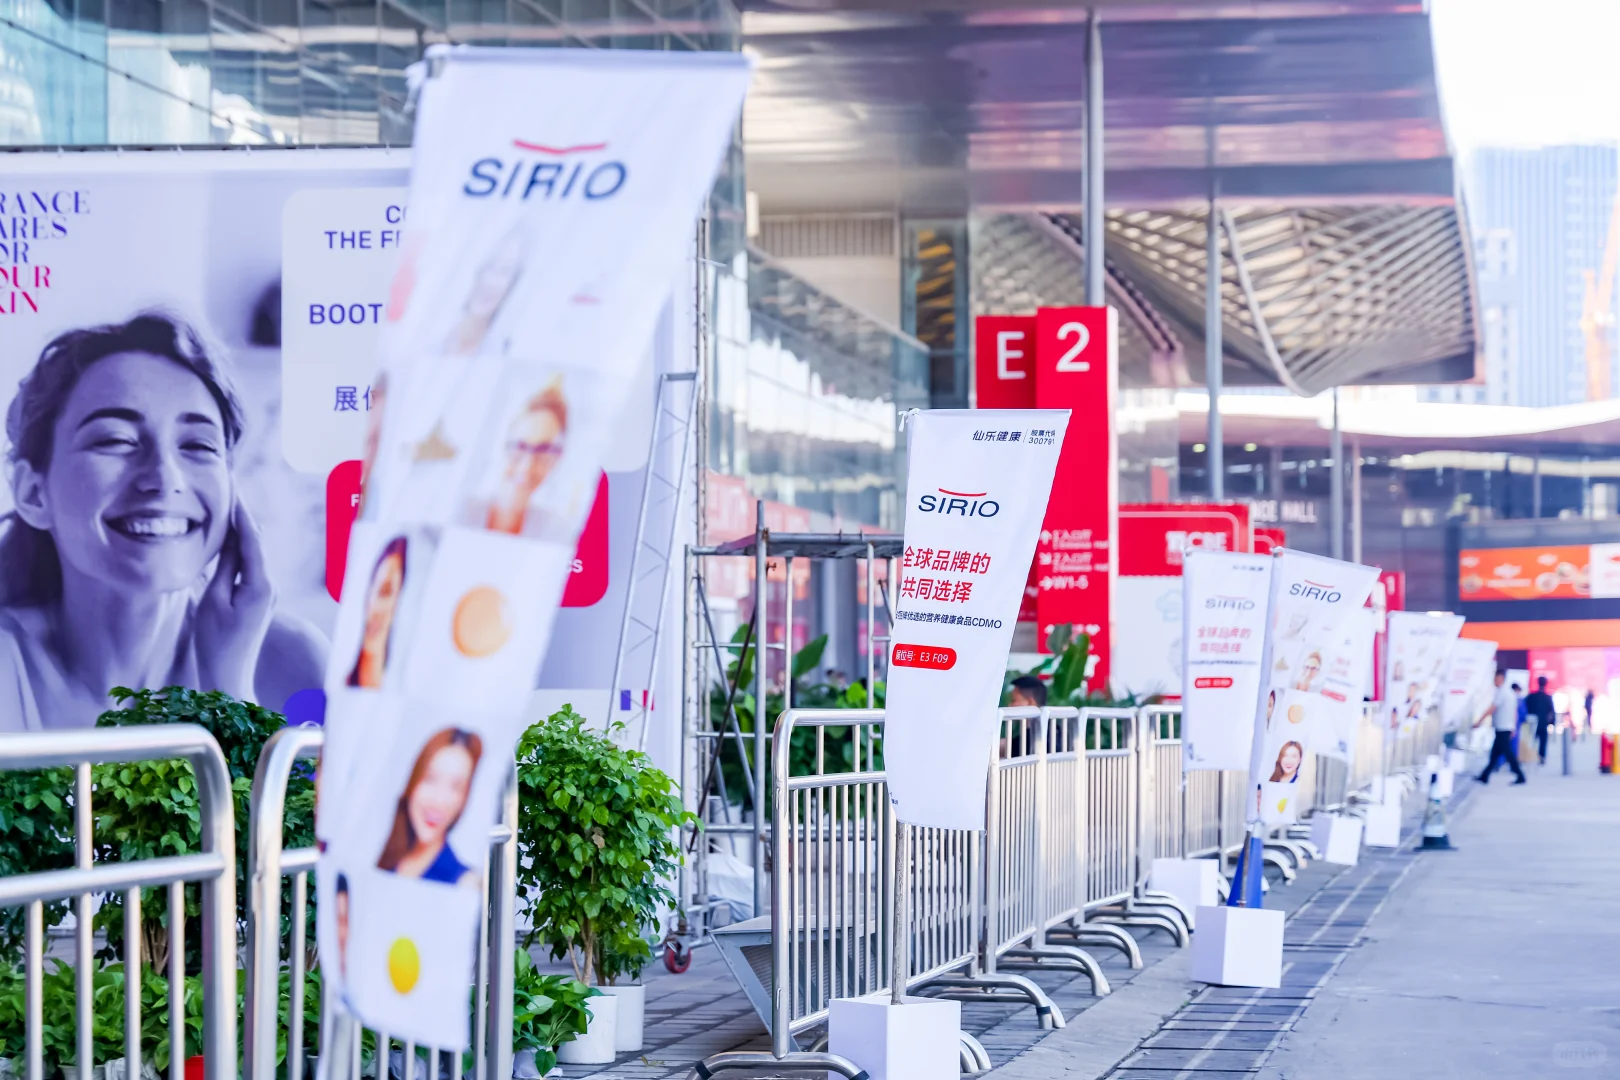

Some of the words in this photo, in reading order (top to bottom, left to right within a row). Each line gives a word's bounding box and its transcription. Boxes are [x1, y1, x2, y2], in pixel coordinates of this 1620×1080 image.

[463, 157, 629, 200] SIRIO
[386, 205, 407, 223] C
[324, 230, 372, 248] THE
[997, 331, 1026, 380] E
[1055, 321, 1091, 373] 2
[972, 430, 1022, 442] 仙乐健康
[918, 494, 1000, 518] SIRIO
[903, 545, 992, 574] 全球品牌的
[902, 576, 973, 603] 共同选择
[1289, 583, 1342, 603] SIRIO
[920, 652, 930, 662] E3
[932, 653, 949, 664] F09
